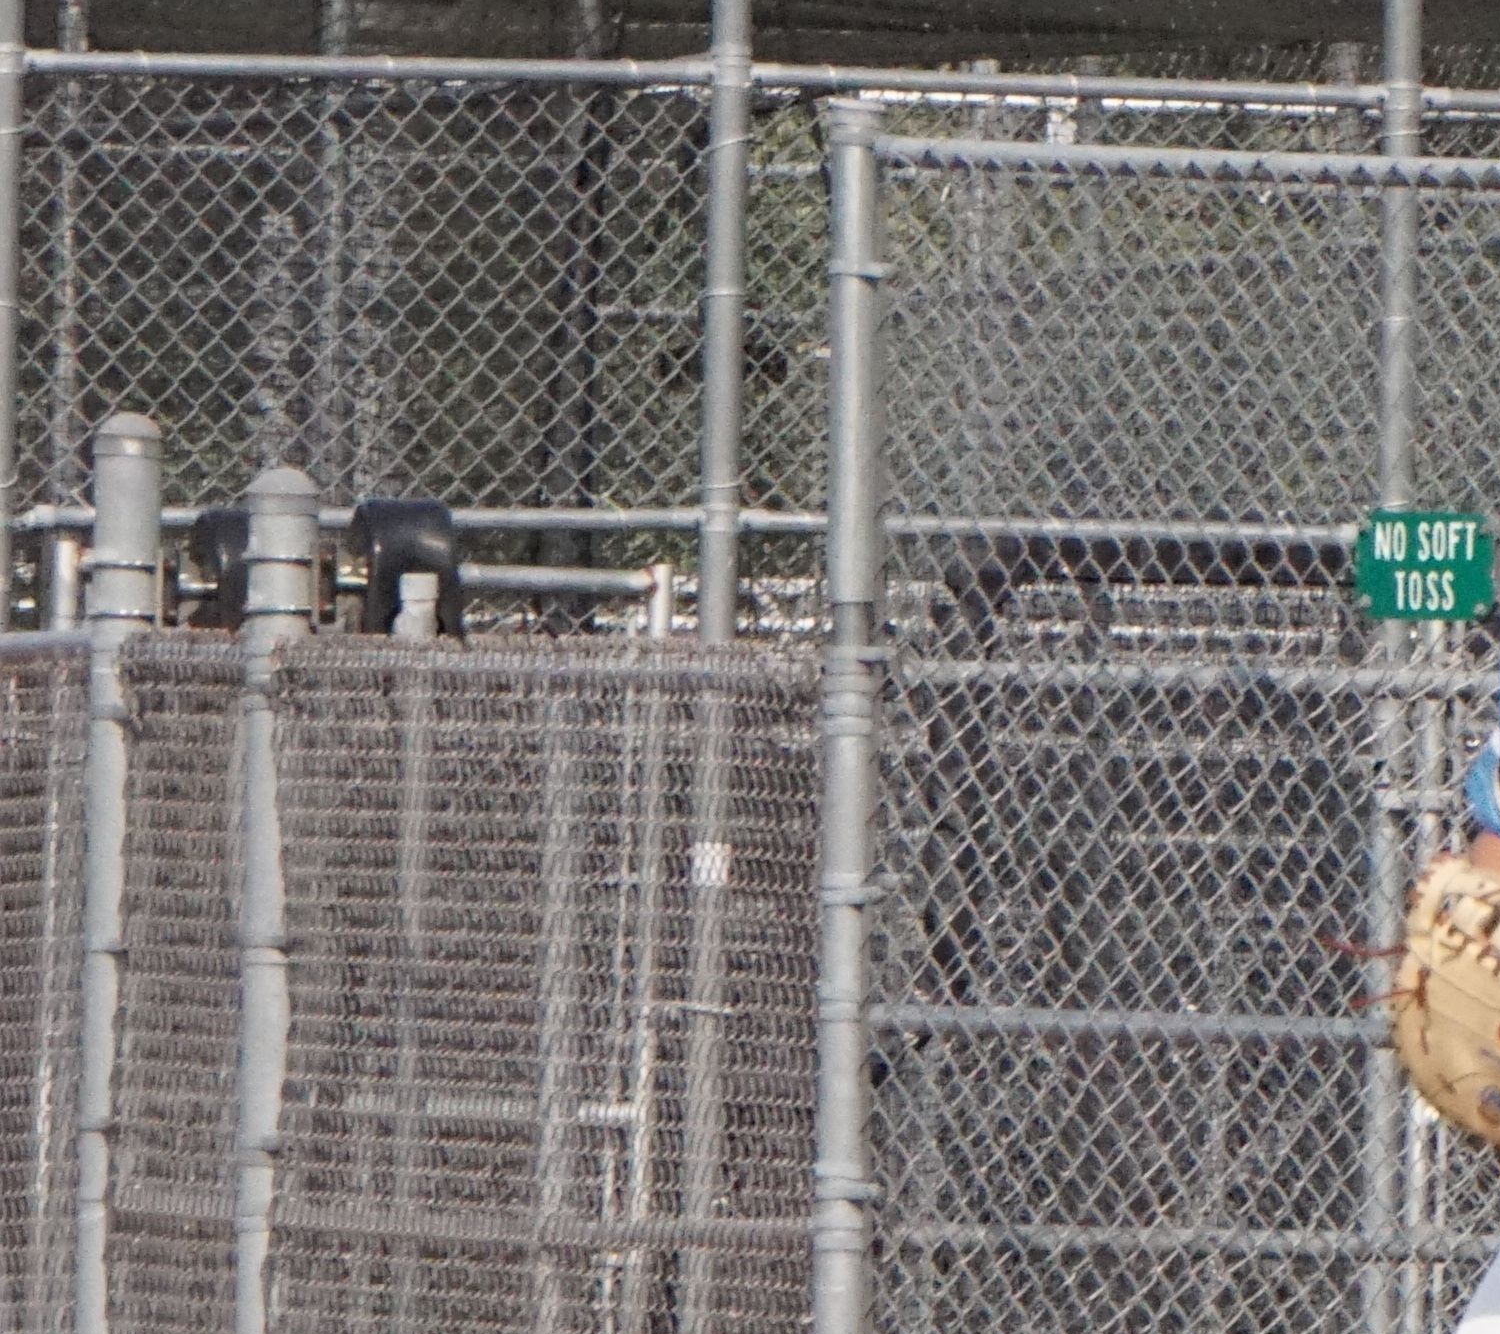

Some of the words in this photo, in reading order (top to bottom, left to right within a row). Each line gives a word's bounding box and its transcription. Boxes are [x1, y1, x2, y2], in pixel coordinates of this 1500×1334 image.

[1374, 521, 1407, 561] NO
[1417, 521, 1477, 562] SOFT
[1394, 570, 1455, 611] TOSS
